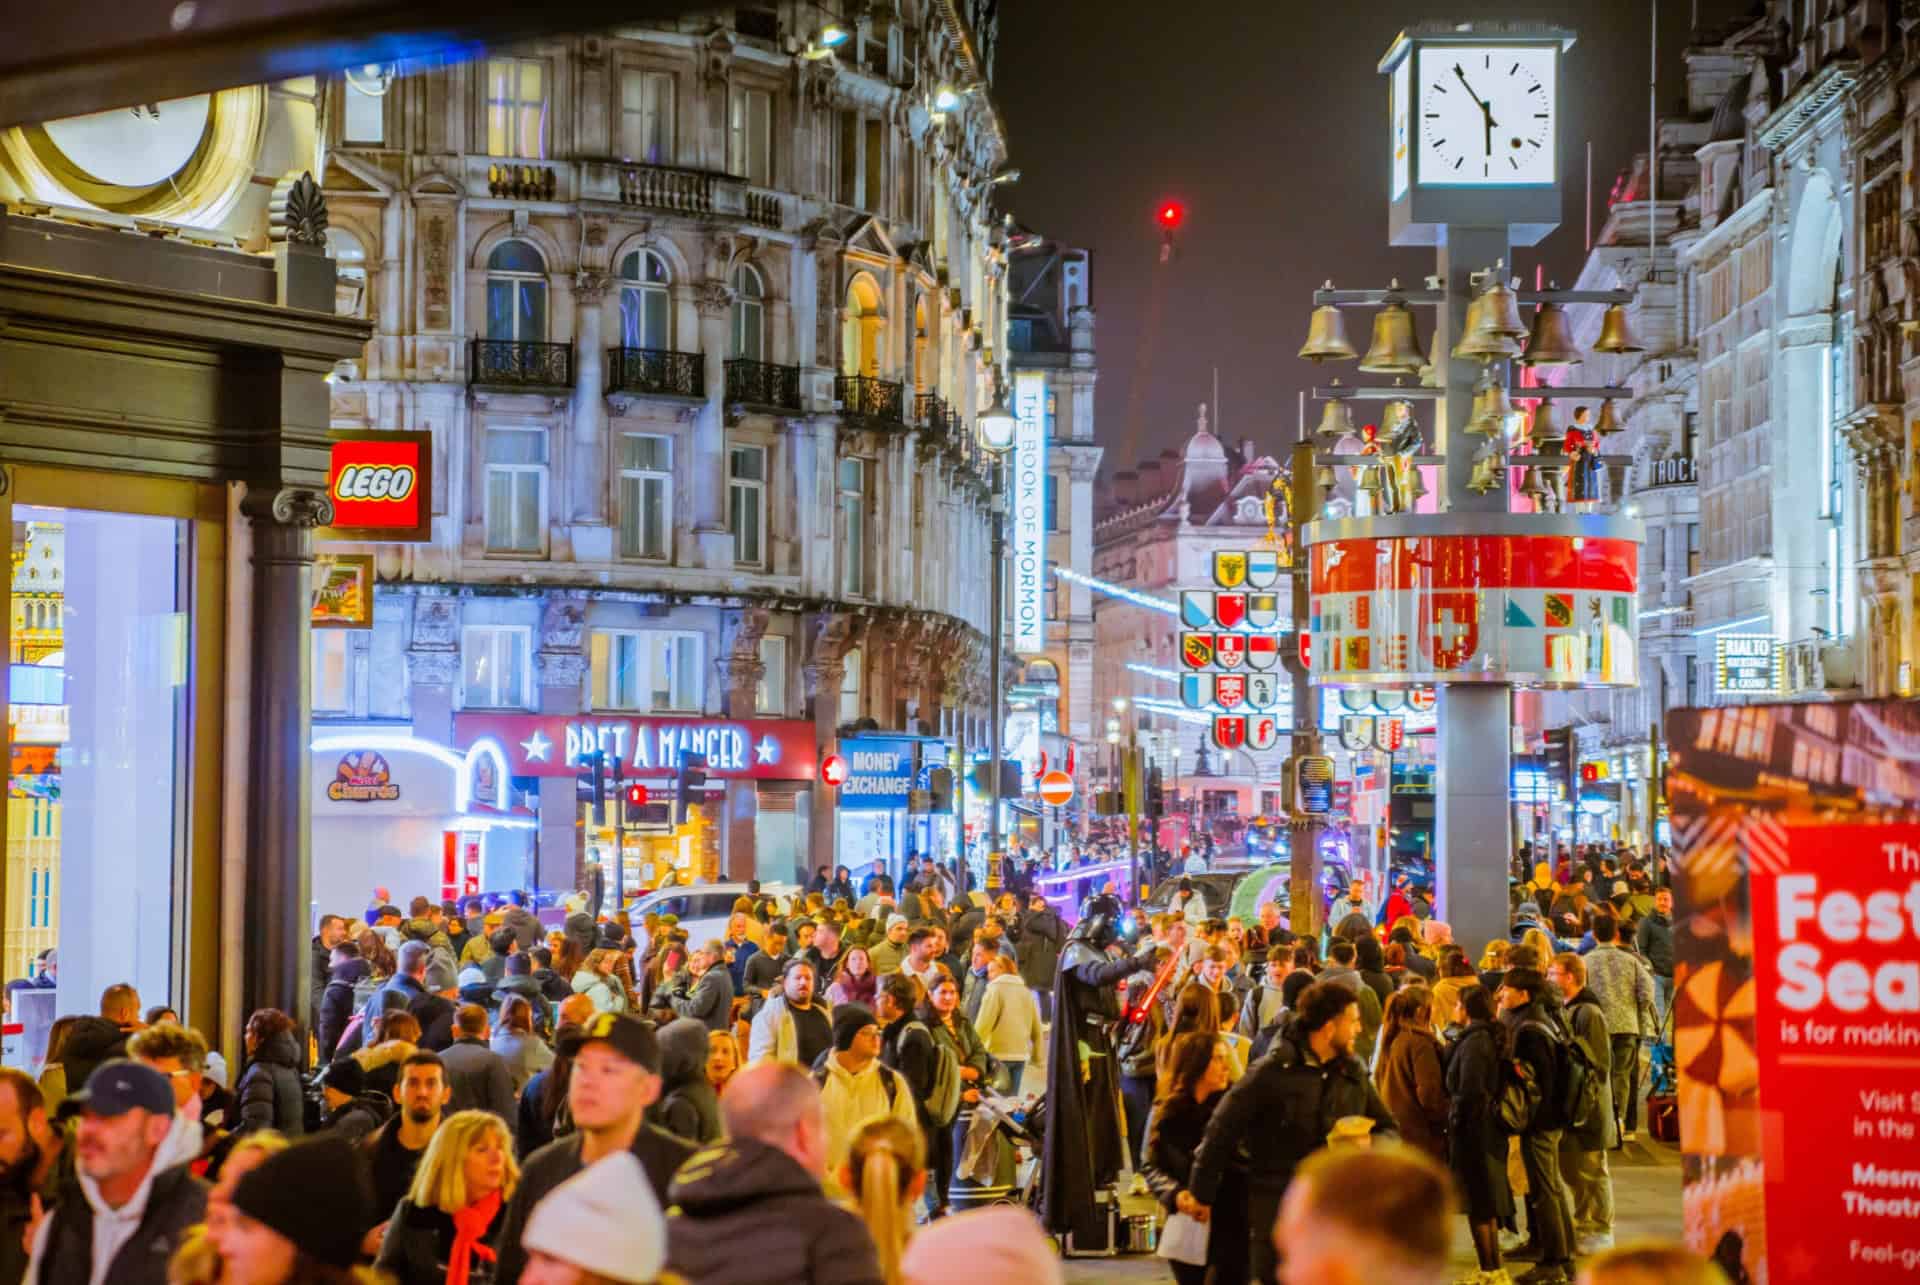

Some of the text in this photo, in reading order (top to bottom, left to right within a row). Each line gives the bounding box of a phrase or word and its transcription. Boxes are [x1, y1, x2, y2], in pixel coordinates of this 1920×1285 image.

[337, 466, 413, 499] LEGO
[1020, 391, 1037, 636] THE BOOK OF MORMON
[1726, 639, 1769, 656] RIALTO
[632, 725, 650, 768] A
[853, 750, 900, 773] MONEY
[841, 775, 911, 795] EXCHANGE
[1881, 842, 1920, 873] Th
[1776, 943, 1920, 1013] Sea
[1780, 1018, 1920, 1046] is for makin
[1859, 1089, 1905, 1113] Visit
[1853, 1115, 1915, 1140] in the
